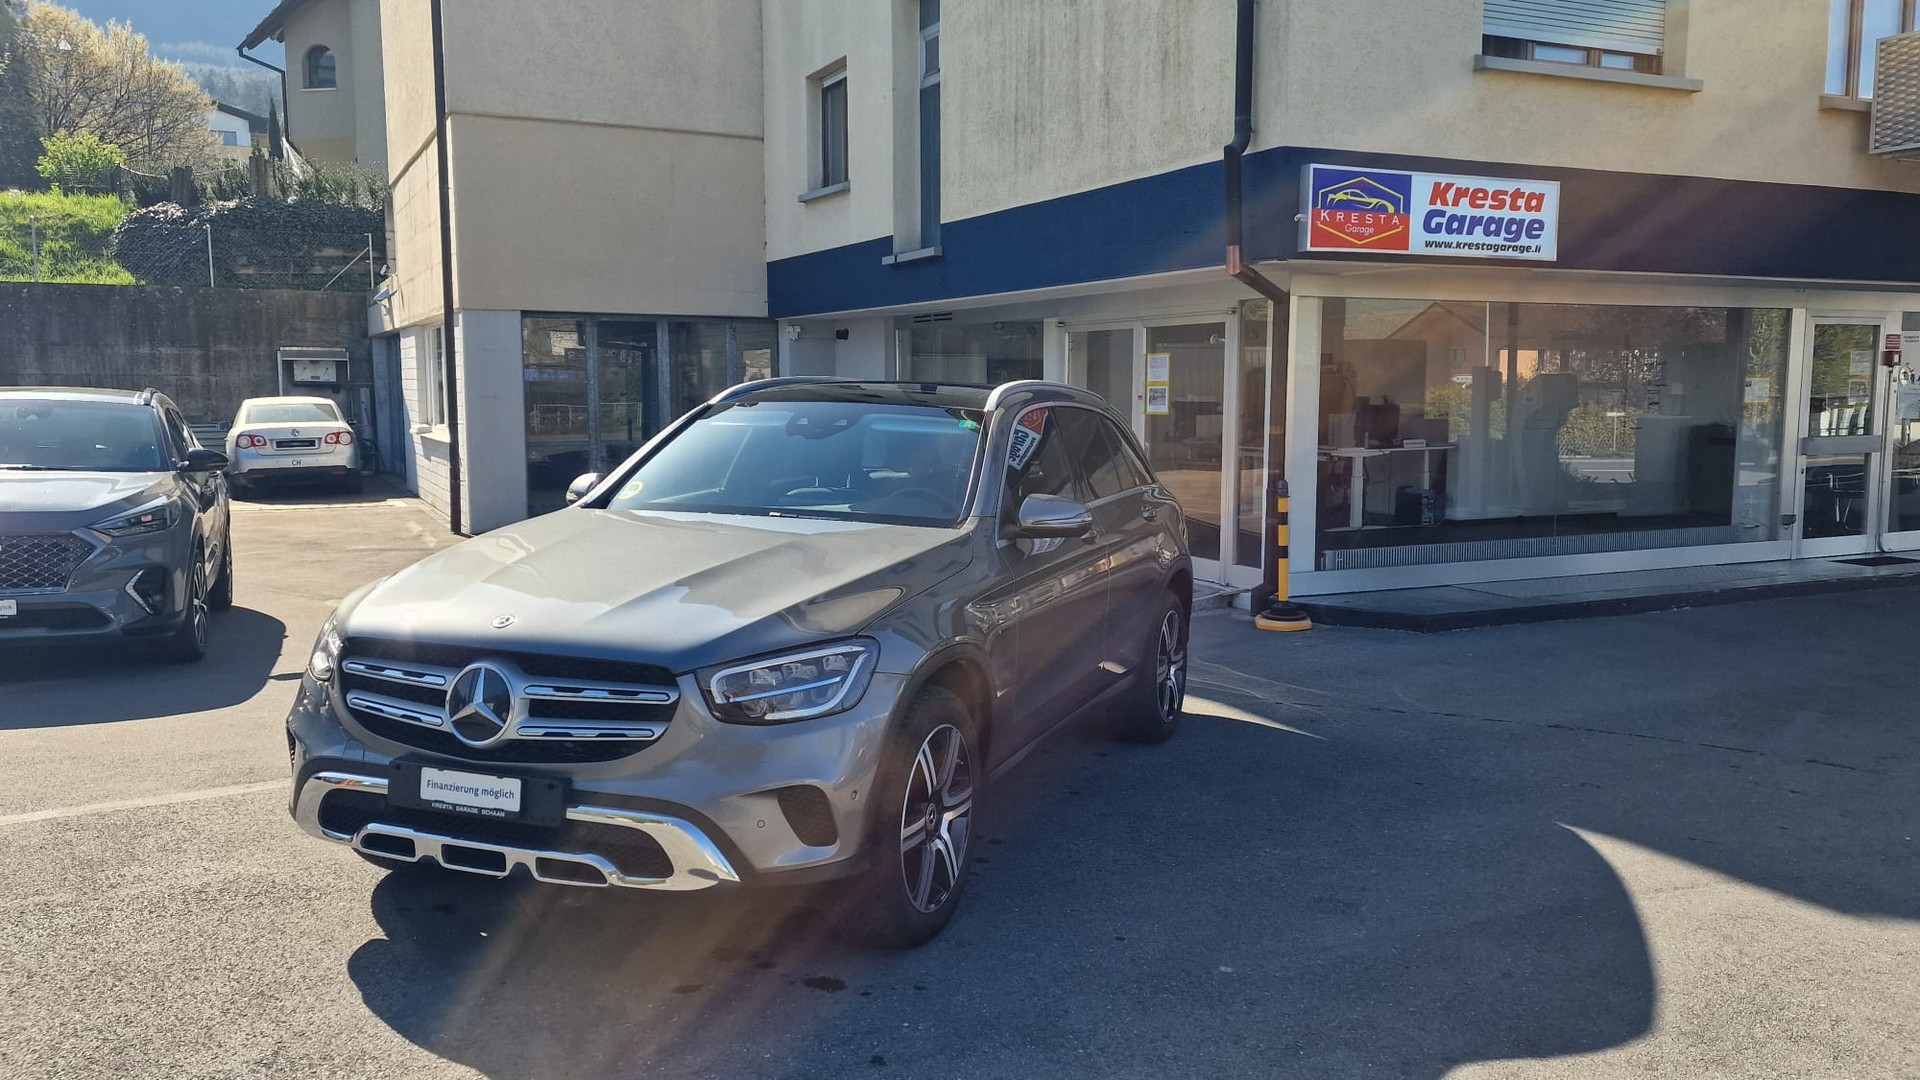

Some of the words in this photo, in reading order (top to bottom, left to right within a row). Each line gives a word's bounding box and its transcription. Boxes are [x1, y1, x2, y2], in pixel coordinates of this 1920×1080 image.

[1429, 181, 1546, 213] Kresta
[1320, 209, 1400, 225] KRESTA
[1423, 209, 1546, 243] Garage
[1344, 223, 1375, 236] Garage
[1424, 239, 1542, 254] www.krestagarage.li
[426, 779, 480, 797] Finanzierung
[481, 787, 515, 800] möglich
